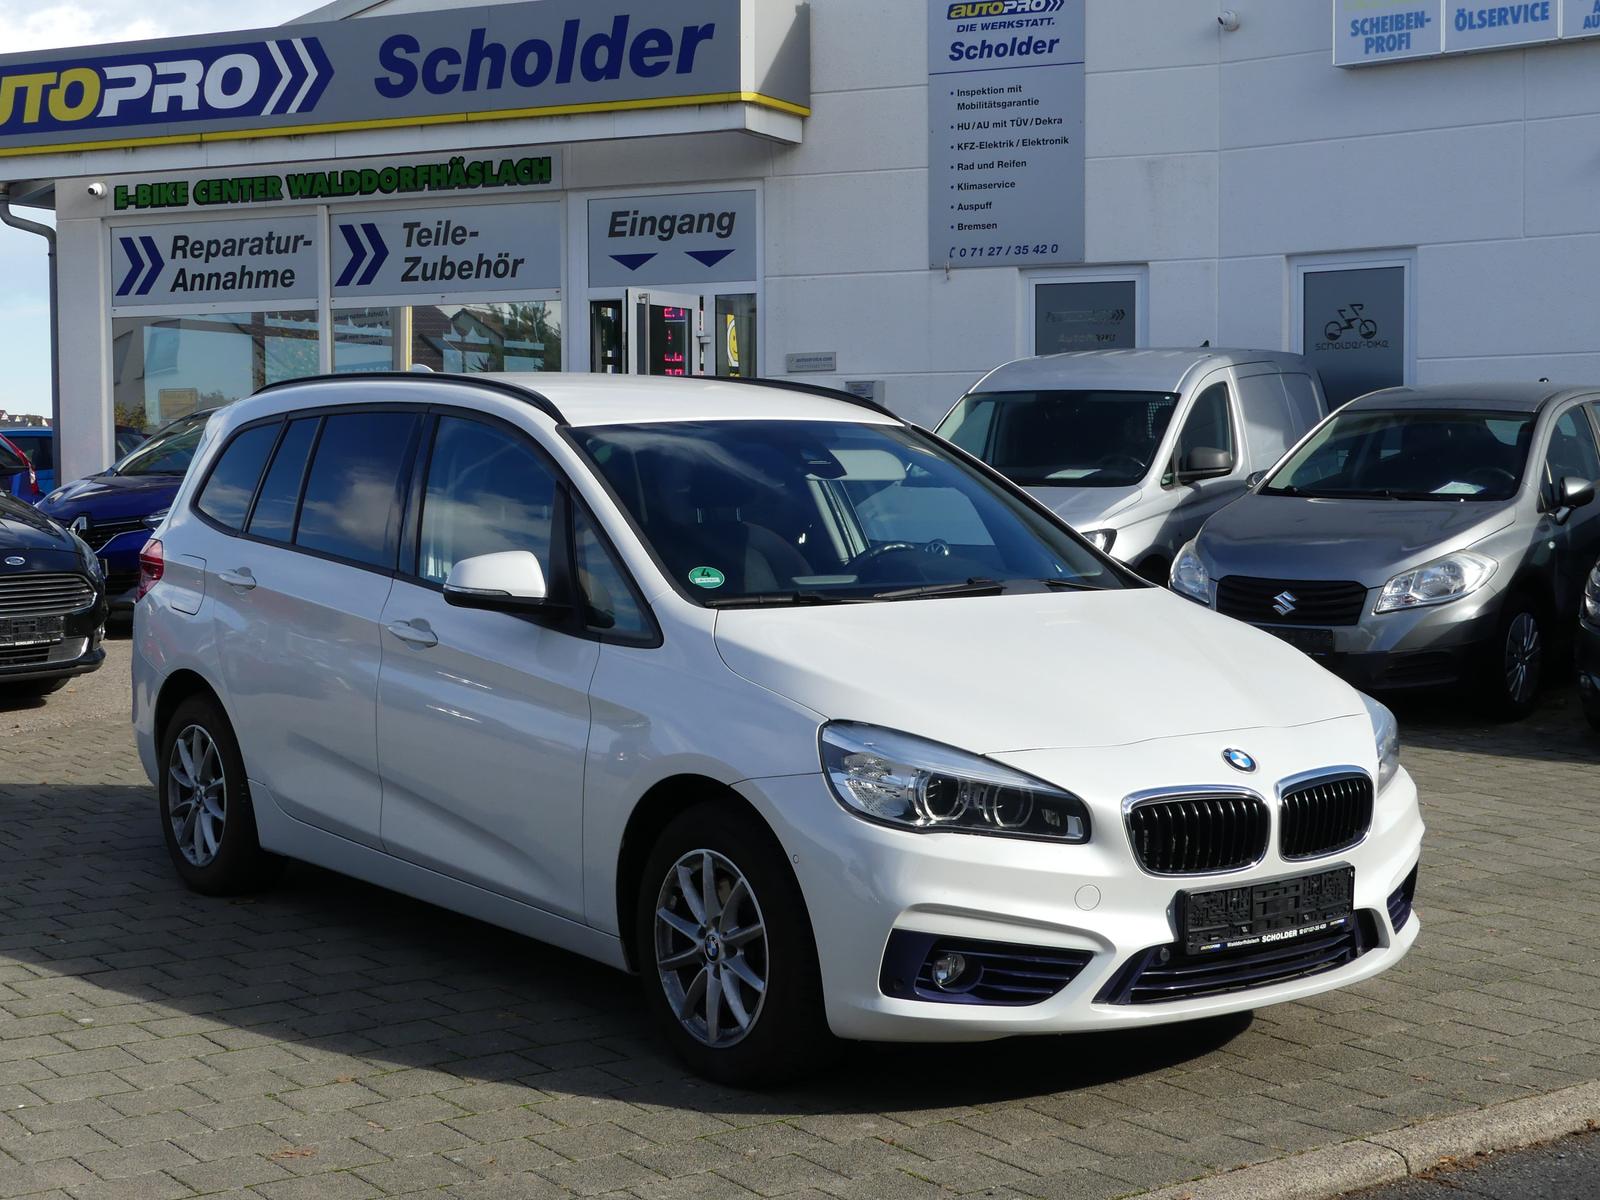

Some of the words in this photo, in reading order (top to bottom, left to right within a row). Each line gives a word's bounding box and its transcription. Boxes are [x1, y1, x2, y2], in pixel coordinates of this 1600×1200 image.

[957, 23, 977, 33] DIE
[981, 17, 1055, 31] WERKSTATT.
[1350, 10, 1431, 37] SCHEIBEN-
[1454, 1, 1549, 31] ÖLSERVICE
[949, 36, 1060, 61] Scholder
[1364, 32, 1411, 55] PROFI
[374, 15, 715, 98] Scholder
[957, 87, 1004, 98] Inspektion
[1007, 84, 1022, 93] mit
[957, 97, 1040, 111] Mobilitätsgarantie
[992, 119, 1007, 129] mit
[957, 140, 1014, 151] KFZ-Elektrik
[1022, 136, 1069, 147] Elektronik
[957, 163, 975, 171] Rad
[978, 161, 995, 170] und
[998, 159, 1027, 168] Reifen
[114, 181, 189, 210] E-BIKE
[193, 176, 284, 205] CENTER
[286, 156, 552, 200] WALDDORFHÄSLACH
[957, 180, 1016, 191] Klimaservice
[957, 202, 993, 212] Auspuff
[403, 220, 480, 248] Teile-
[608, 209, 737, 242] Eingang
[957, 222, 998, 231] Bremsen
[170, 231, 313, 263] Reparatur-
[401, 252, 525, 283] Zubehör
[170, 265, 296, 293] Annahme
[701, 568, 711, 577] 4
[1262, 929, 1298, 943] SCHOLDER
